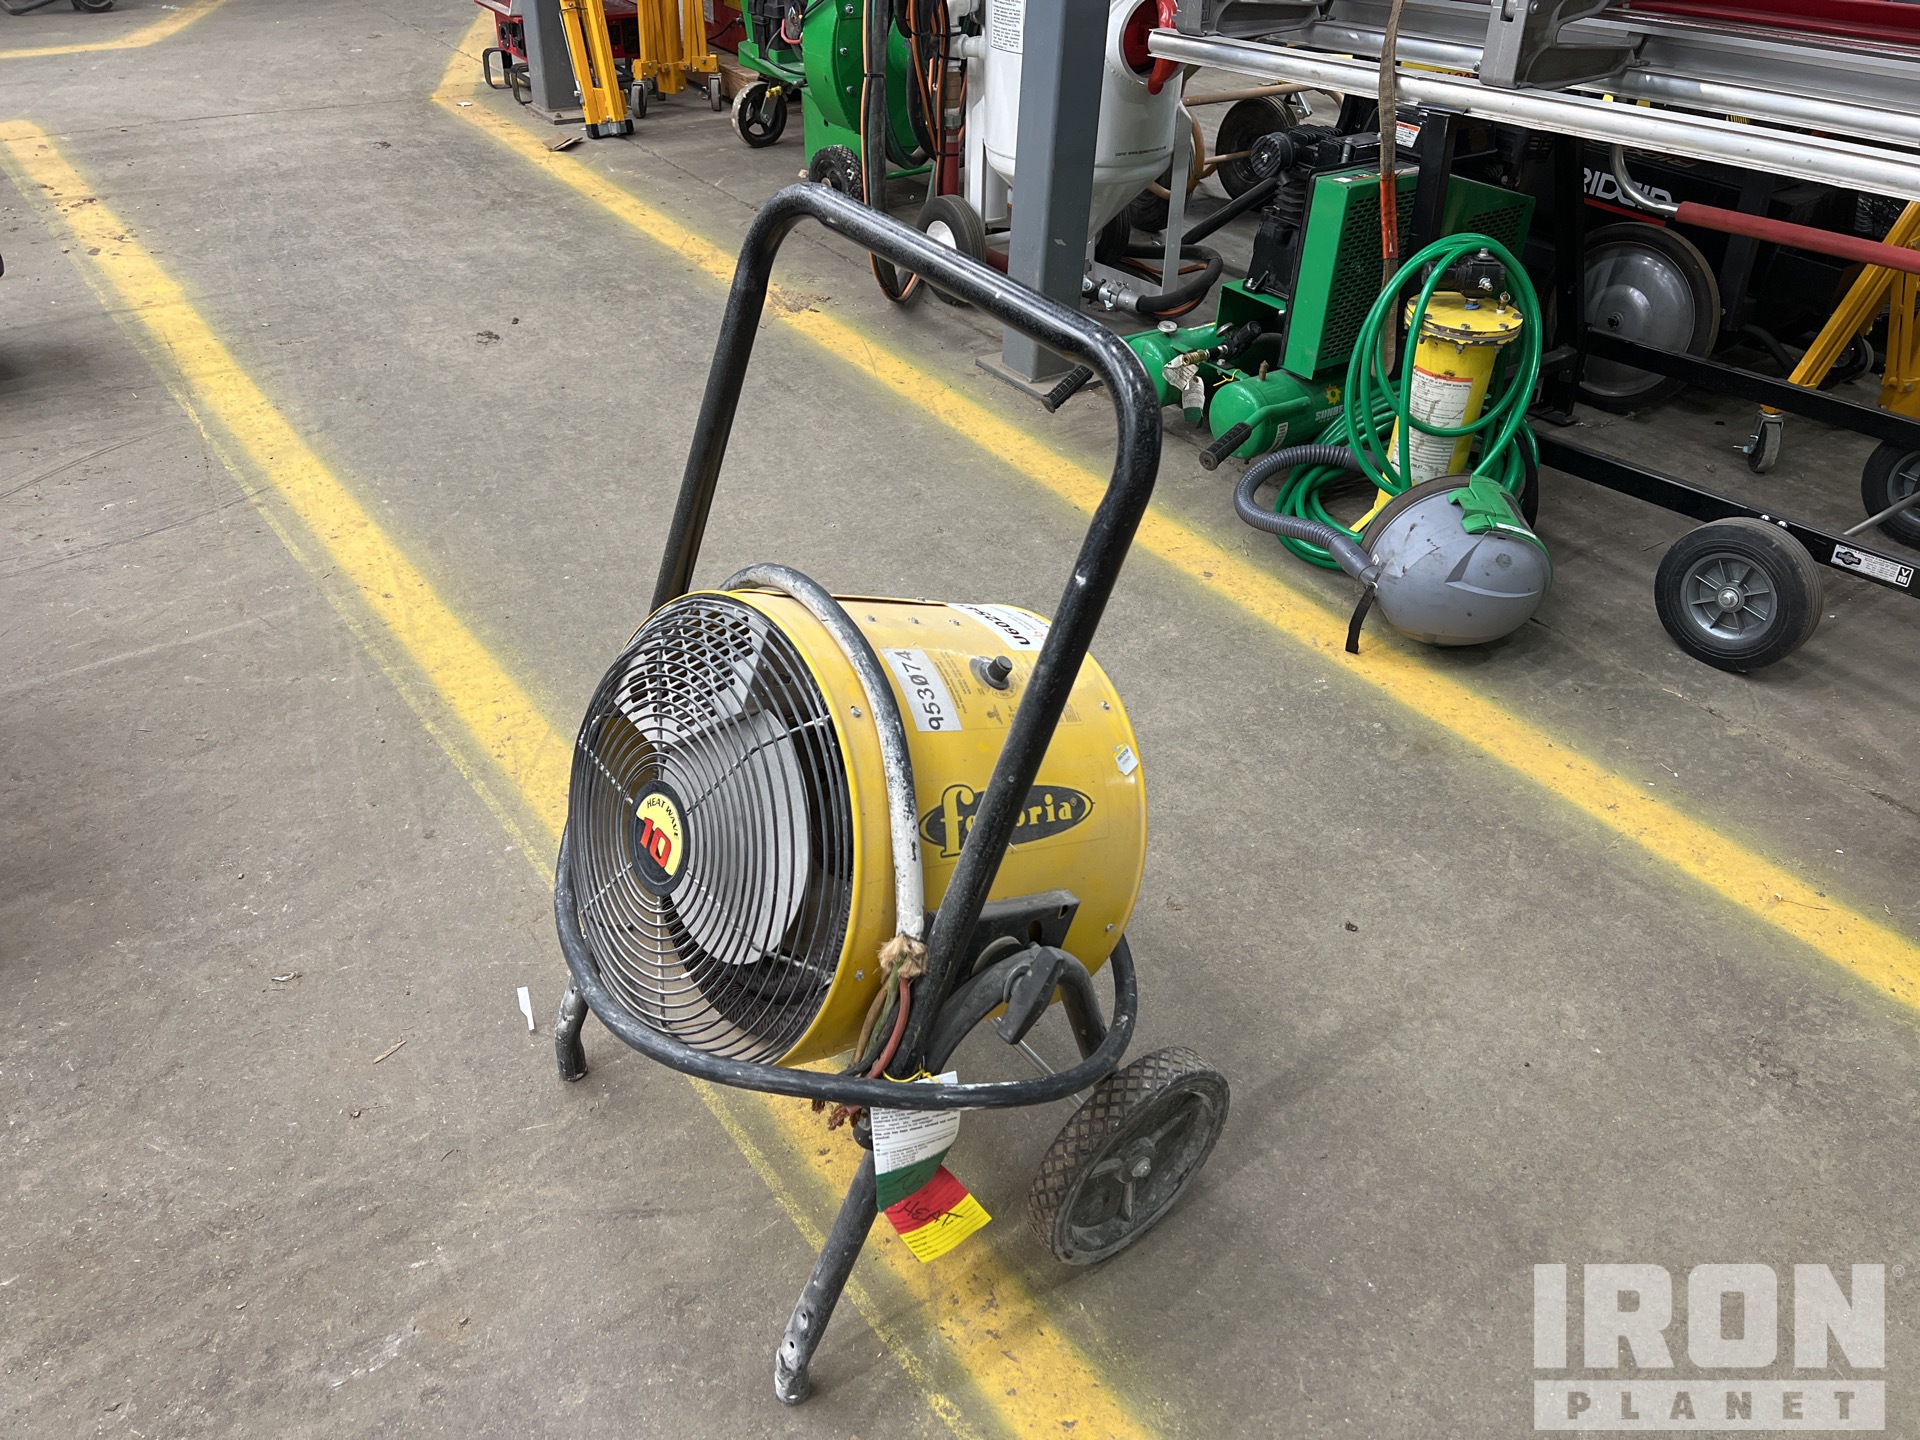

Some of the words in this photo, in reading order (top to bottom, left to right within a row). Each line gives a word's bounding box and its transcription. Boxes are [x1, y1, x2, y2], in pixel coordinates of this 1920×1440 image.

[895, 650, 944, 731] 953074
[640, 816, 672, 868] 10
[646, 797, 666, 809] HEAT
[665, 805, 679, 838] WAVE
[941, 785, 1072, 857] fooria
[897, 1200, 964, 1228] HEAT
